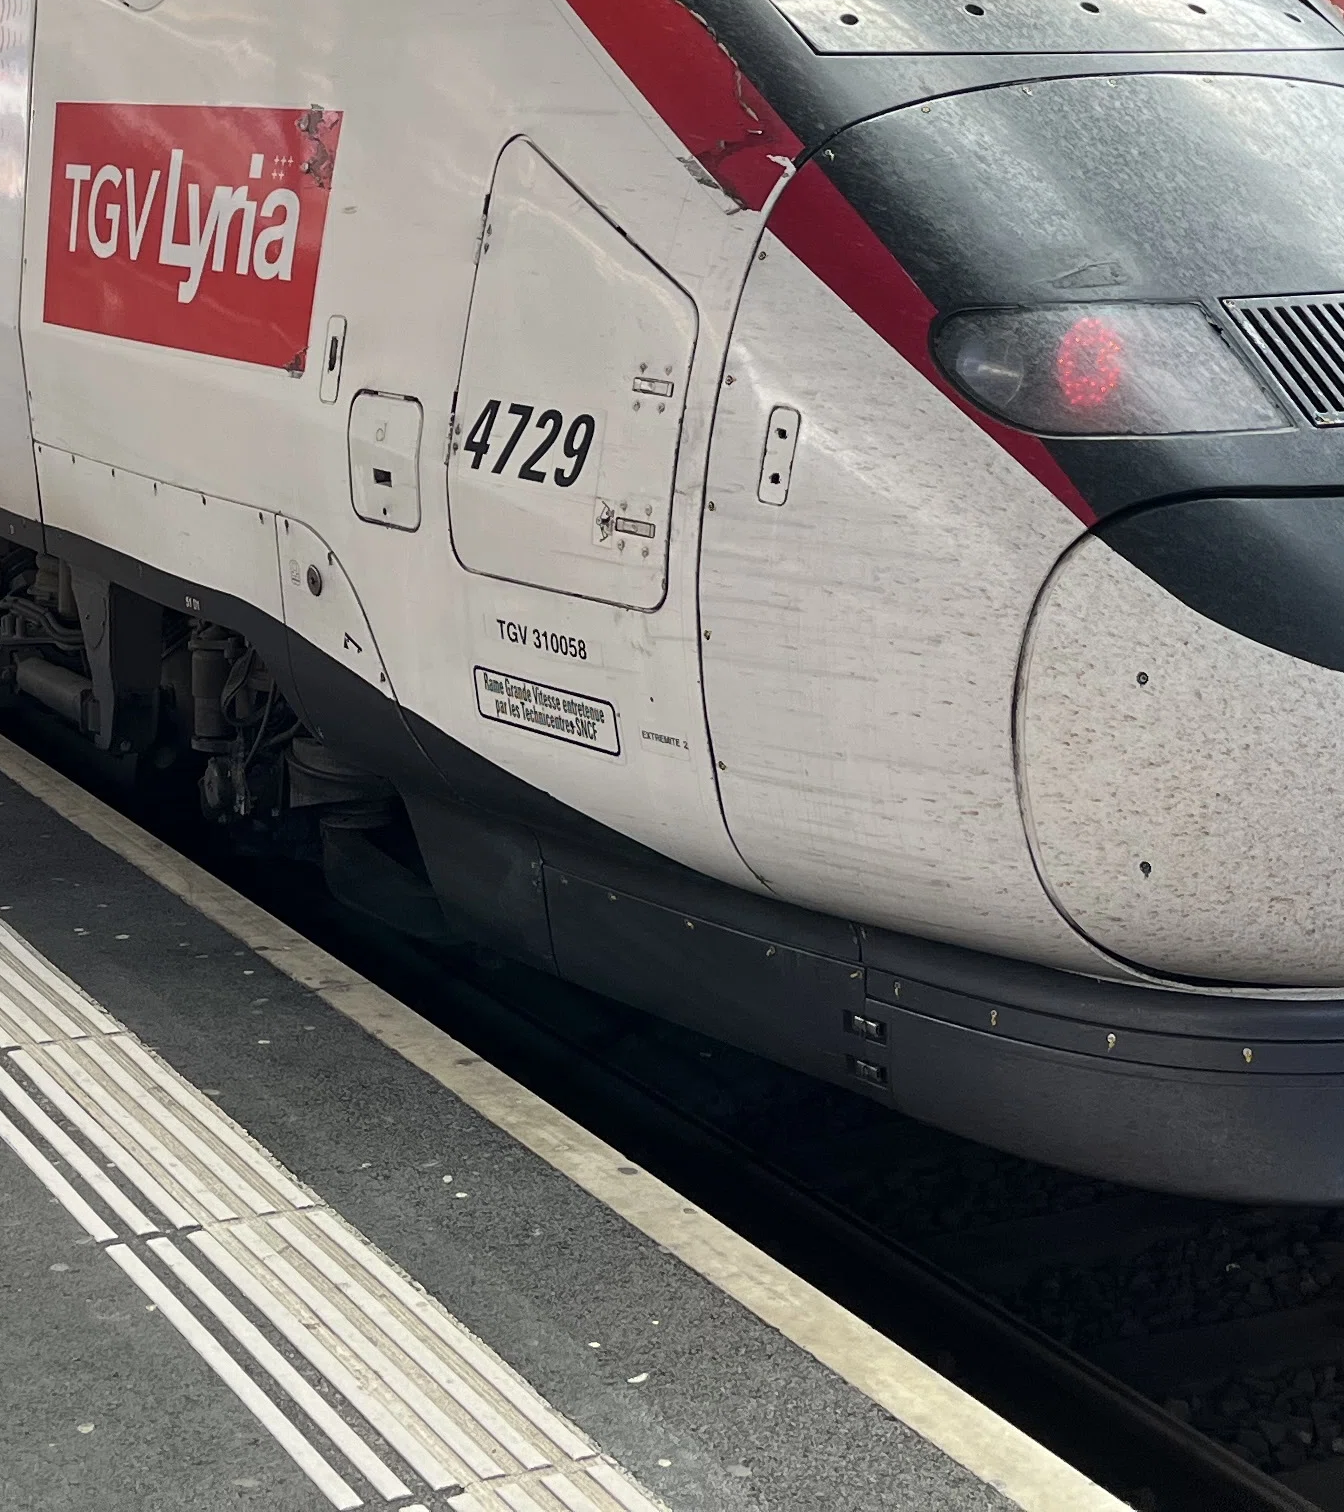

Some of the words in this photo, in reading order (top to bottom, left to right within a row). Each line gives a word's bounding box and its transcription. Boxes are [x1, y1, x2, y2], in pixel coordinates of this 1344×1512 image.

[65, 162, 161, 261] TGV
[158, 148, 301, 304] Lyria
[463, 399, 596, 487] 4729
[496, 618, 528, 645] TGV
[532, 628, 587, 660] 310058
[483, 672, 505, 695] Rame
[505, 677, 532, 702] Grande
[531, 685, 561, 711] Vitesse
[562, 697, 605, 723] entretenue
[495, 698, 507, 717] par
[508, 699, 521, 719] les
[575, 719, 598, 741] SNCF
[683, 740, 689, 750] 2
